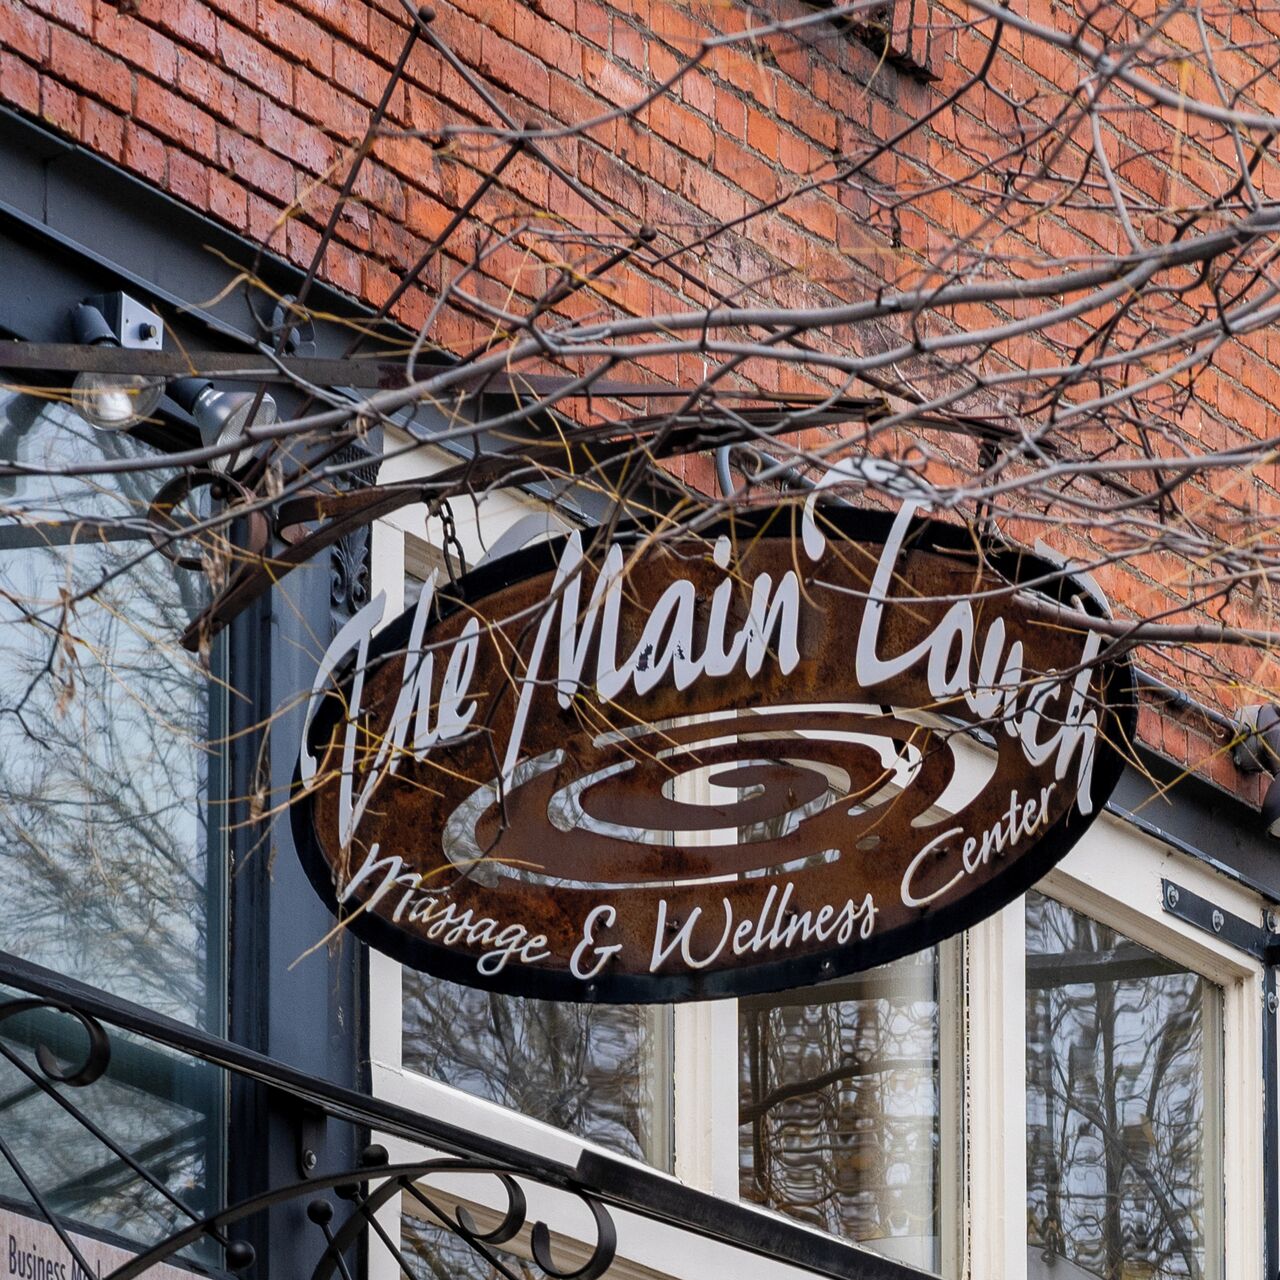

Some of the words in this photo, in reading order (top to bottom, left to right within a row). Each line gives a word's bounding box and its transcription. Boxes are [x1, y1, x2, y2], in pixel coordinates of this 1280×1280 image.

[301, 568, 479, 848] The
[499, 529, 800, 795] Main
[801, 457, 1100, 814] Touch
[339, 844, 550, 975] Massage
[570, 904, 623, 980] &
[649, 883, 879, 971] Wellness
[900, 782, 1058, 907] Center
